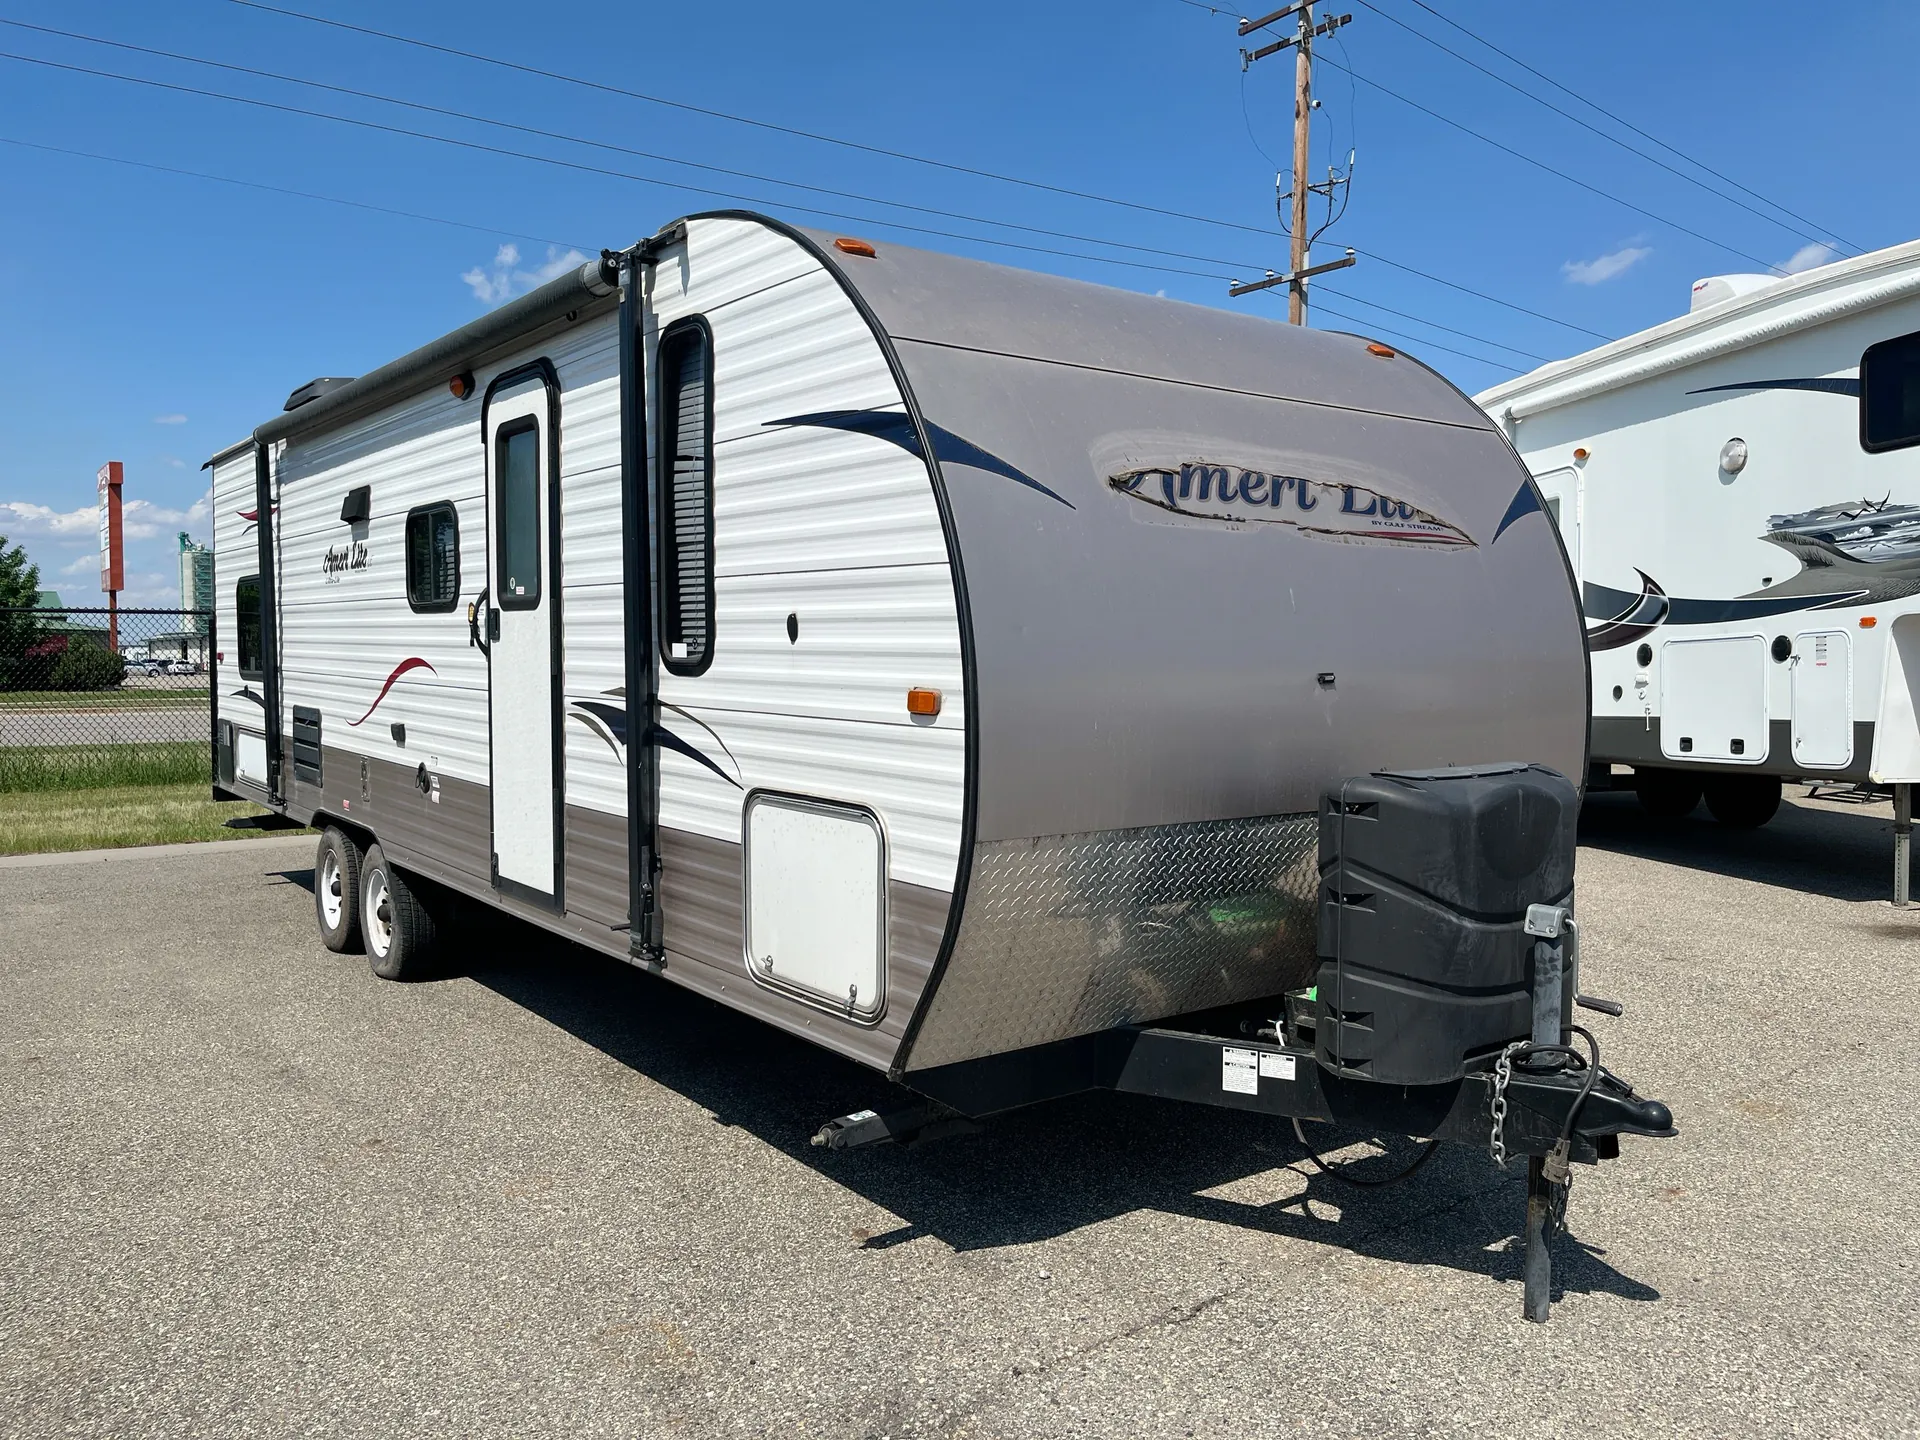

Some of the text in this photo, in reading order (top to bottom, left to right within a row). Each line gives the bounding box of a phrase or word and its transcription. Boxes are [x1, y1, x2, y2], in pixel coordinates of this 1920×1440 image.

[1340, 486, 1415, 520] Li
[1371, 519, 1383, 527] BY
[1384, 521, 1405, 529] GULF
[322, 544, 349, 577] Ameri
[350, 539, 368, 570] Lite
